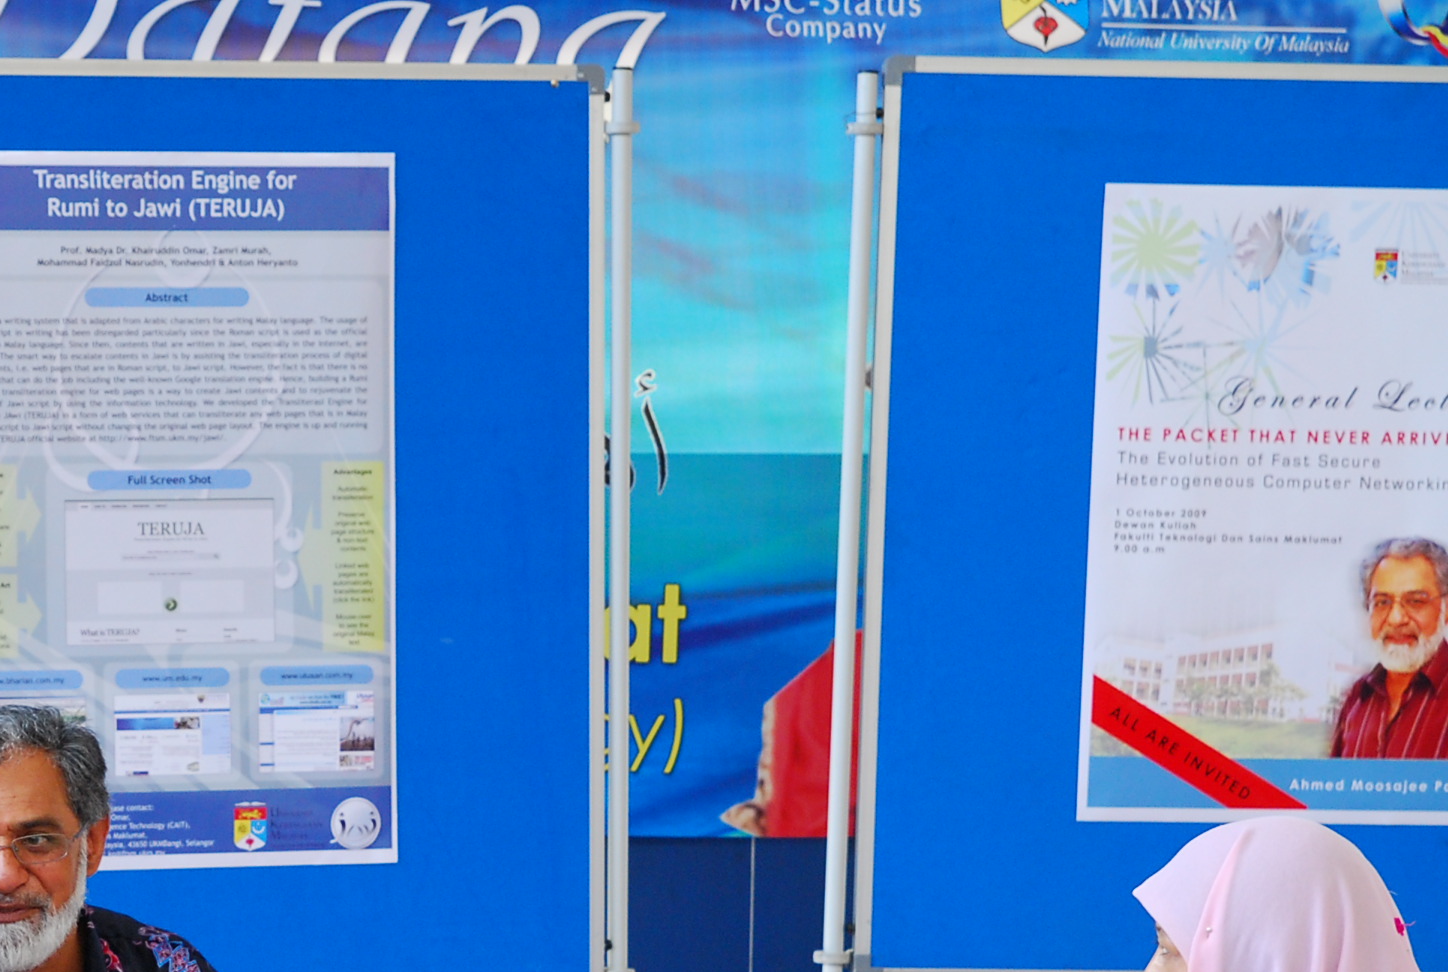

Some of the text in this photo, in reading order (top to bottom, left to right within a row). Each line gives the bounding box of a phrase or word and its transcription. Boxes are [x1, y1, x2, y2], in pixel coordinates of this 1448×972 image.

[766, 13, 887, 45] Company
[1098, 31, 1350, 55] National University Of Malaysia
[33, 169, 297, 193] Transliteration Engine for
[47, 198, 285, 221] Rumi to Jawi (TERUJA)
[60, 246, 82, 255] Prof.
[86, 246, 113, 256] Madya
[132, 246, 180, 255] Khairuddin
[212, 246, 238, 255] Zamri
[37, 258, 87, 267] Mohammad
[228, 258, 254, 267] Anton
[257, 258, 298, 269] Heryanto
[145, 292, 188, 303] Abstract
[1217, 375, 1358, 416] General
[1117, 427, 1152, 442] THE
[1163, 427, 1240, 443] PACKET
[1249, 429, 1296, 443] THAT
[1307, 430, 1371, 445] NEVER
[1118, 451, 1381, 468] The Evolution of Fast Secure
[128, 475, 211, 485] Full Screen Shot
[1116, 473, 1255, 490] Heterogeneous
[1263, 474, 1351, 492] Computer
[1127, 508, 1175, 518] October
[1180, 509, 1207, 518] 2009
[137, 522, 205, 536] TERUJA
[1114, 520, 1197, 530] Dewan Kuliah
[1114, 532, 1343, 545] Fakulti Teknologi Dan Sains Maklumat
[1109, 706, 1250, 799] ALL ARE INVITED
[1289, 779, 1344, 792] Ahmed
[1351, 779, 1427, 794] Moosajee
